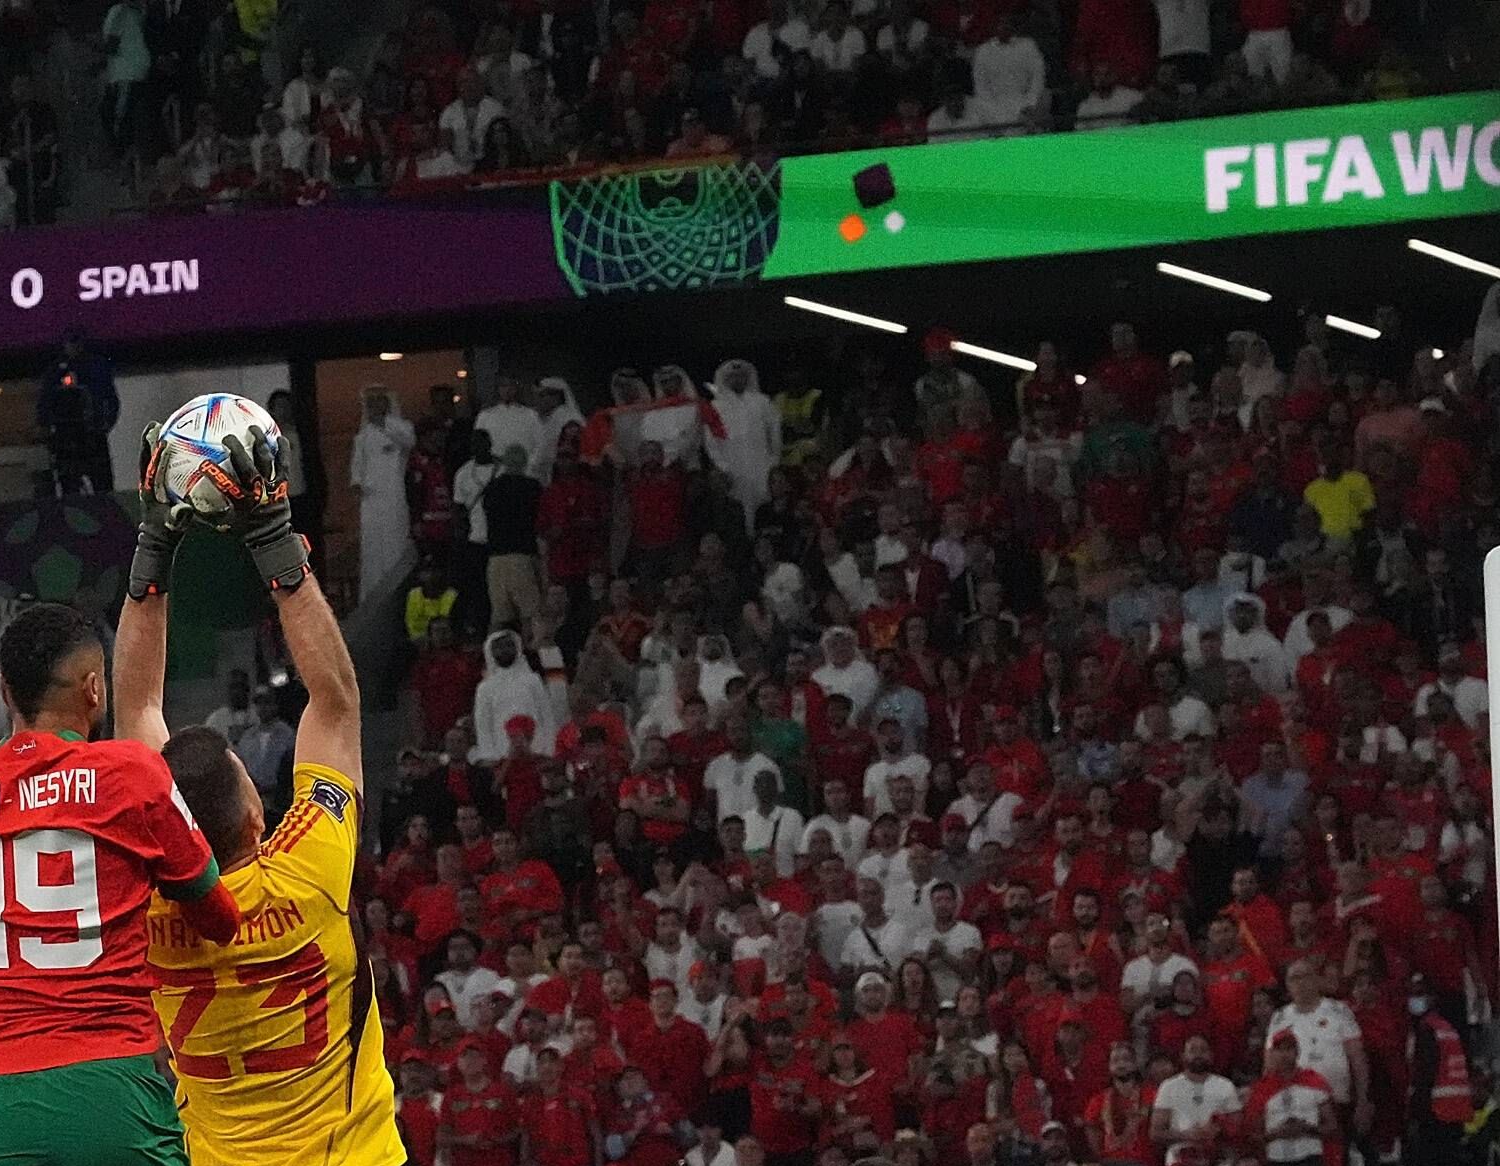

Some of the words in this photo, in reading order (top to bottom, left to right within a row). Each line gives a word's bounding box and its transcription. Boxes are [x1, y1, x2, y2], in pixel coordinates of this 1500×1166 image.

[1204, 136, 1385, 213] FIFA
[11, 268, 43, 308] 0
[79, 259, 200, 301] SPAIN
[150, 943, 328, 1079] 23
